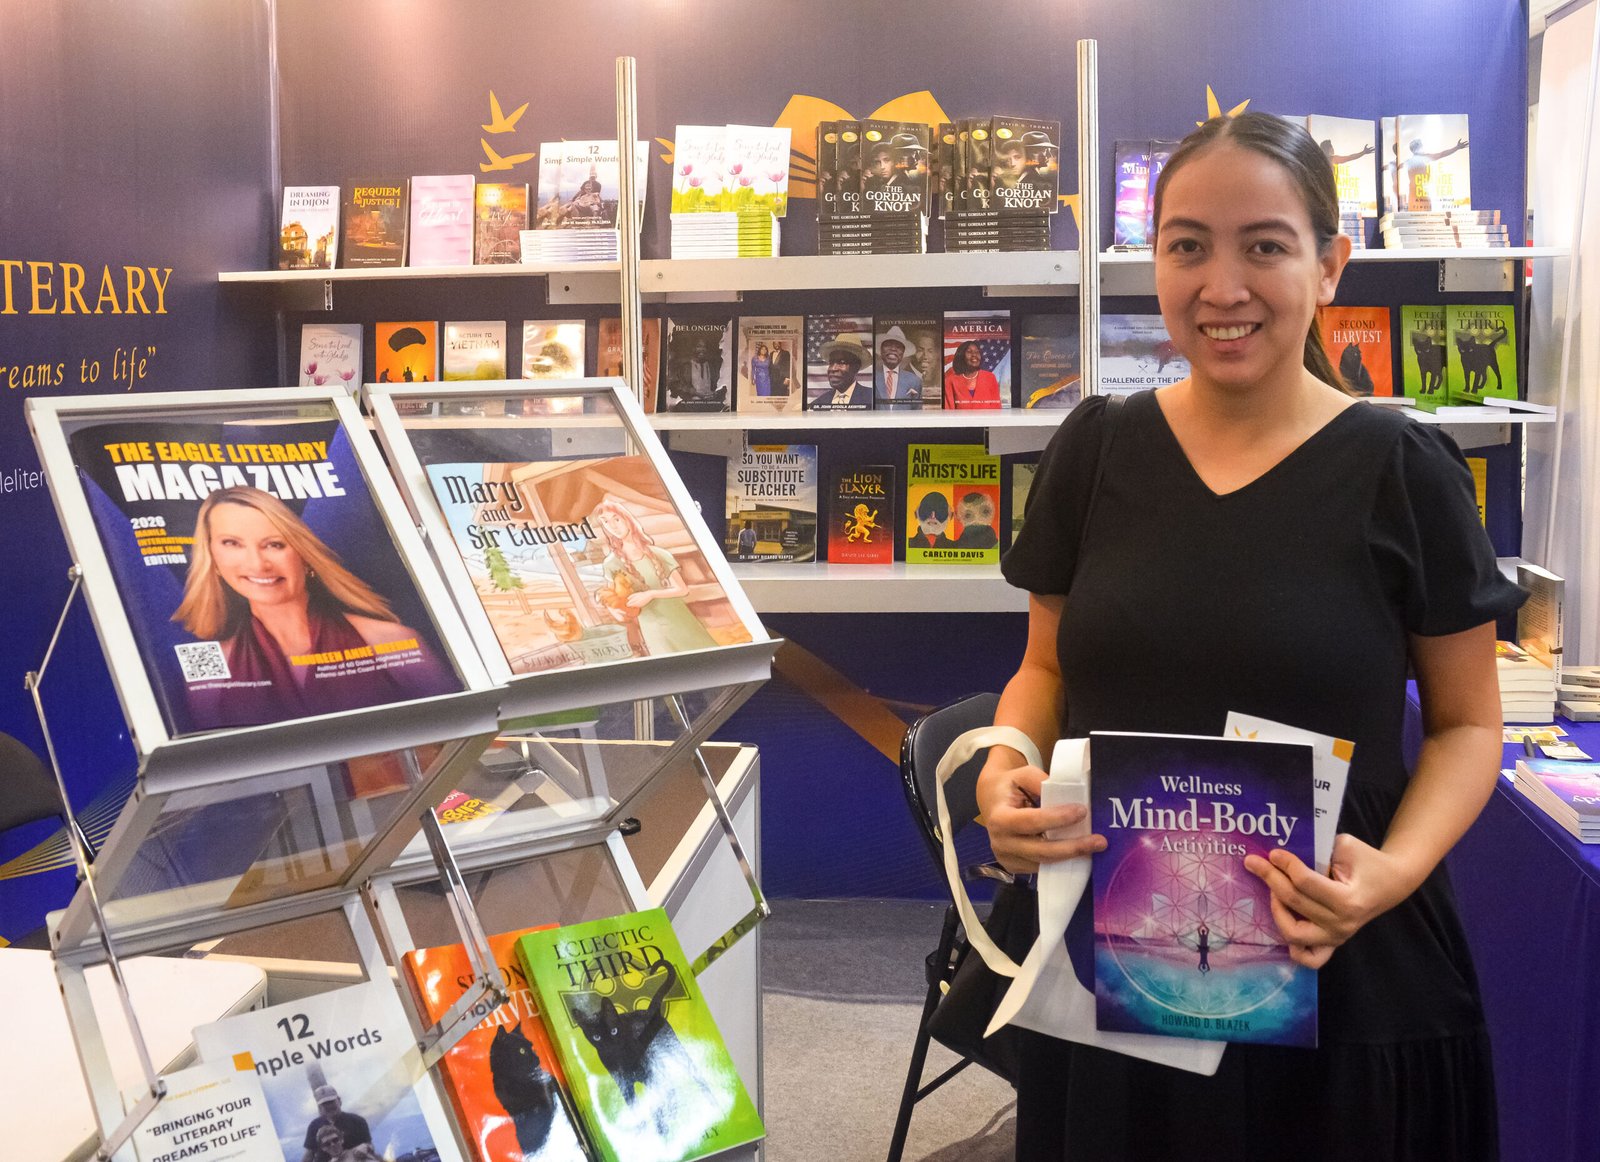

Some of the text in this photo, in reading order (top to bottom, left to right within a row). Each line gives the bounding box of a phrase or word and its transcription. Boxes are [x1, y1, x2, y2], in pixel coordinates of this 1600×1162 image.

[588, 145, 600, 154] 12
[566, 155, 619, 164] Simple Words
[885, 185, 903, 193] THE
[1015, 182, 1033, 190] THE
[354, 187, 401, 200] REQUIEM
[866, 191, 921, 202] GORDIAN
[996, 187, 1052, 199] GORDIAN
[290, 199, 330, 207] IN DIJON
[360, 198, 394, 208] JUSTICE
[874, 201, 912, 212] KNOT
[1004, 198, 1043, 208] KNOT
[0, 259, 173, 315] TERARY
[1457, 310, 1504, 319] ECLECTIC
[675, 324, 726, 332] BELONGING
[952, 325, 1003, 333] AMERICA
[1339, 320, 1376, 329] SECOND
[1457, 319, 1505, 331] THIRD
[1333, 330, 1383, 343] HARVEST
[450, 339, 500, 350] VIETNAM
[80, 358, 100, 383] to
[104, 440, 329, 463] THE EAGLE LITERARY
[912, 448, 930, 463] AN
[742, 454, 799, 464] SO YOU WANT
[737, 470, 805, 483] SUBSTITUTE
[912, 463, 997, 479] ARTIST'S LIFE
[114, 462, 347, 502] MAGAZINE
[853, 473, 882, 483] LION
[442, 475, 525, 512] Mary
[744, 484, 796, 496] TEACHER
[839, 484, 885, 495] SLAYER
[481, 505, 510, 523] and
[130, 516, 166, 530] 2026
[466, 517, 598, 550] Sir Edward
[143, 554, 188, 567] EDITION
[960, 551, 984, 559] DAVIS
[1160, 775, 1242, 796] Wellness
[1108, 796, 1299, 846] Mind-Body
[1159, 835, 1247, 856] Activities
[553, 925, 654, 961] ECLECTIC
[557, 944, 665, 989] THIRD
[277, 1013, 314, 1043] 12
[1161, 1013, 1251, 1032] HOWARD D. BLAZEK
[307, 1027, 383, 1060] Words
[146, 1097, 252, 1137] "BRINGING YOUR
[173, 1117, 233, 1146] LITERARY
[152, 1124, 262, 1162] DREAMS TO LIFE"
